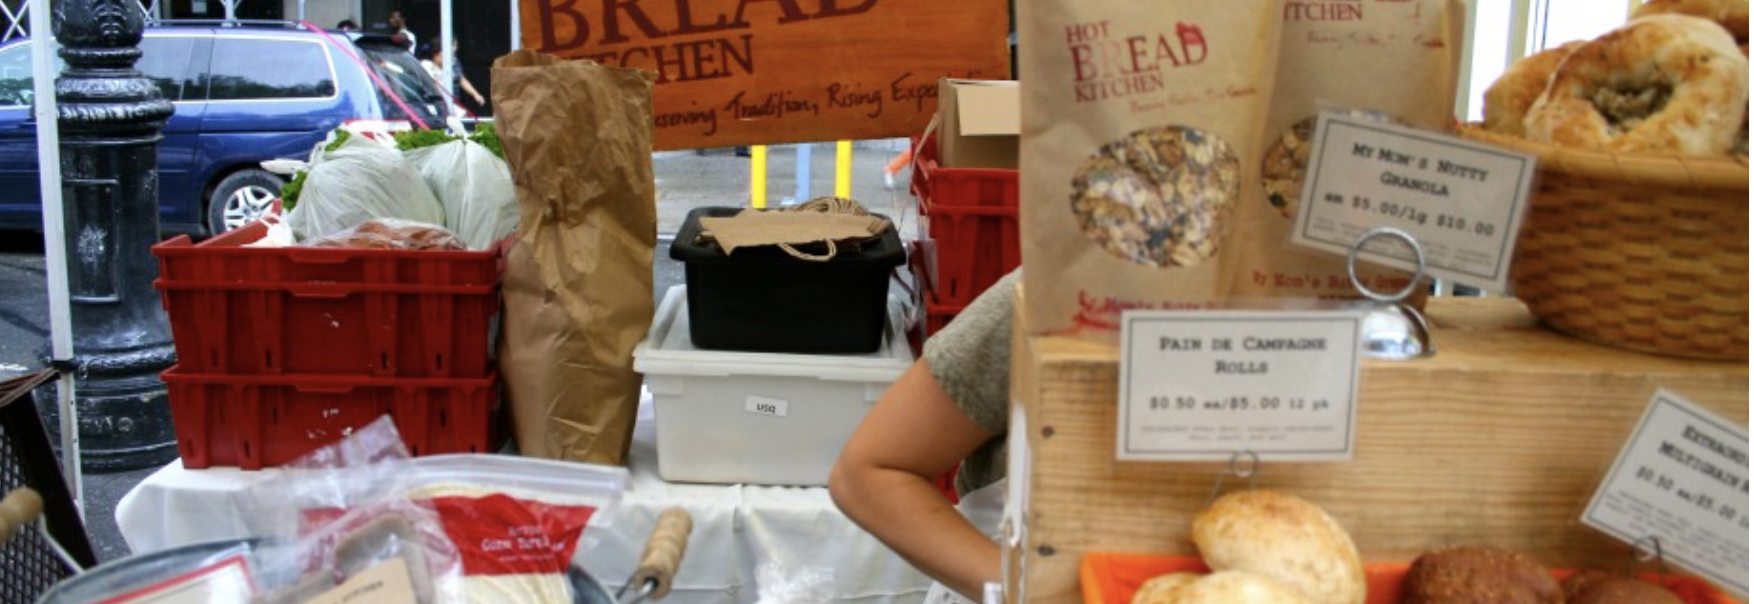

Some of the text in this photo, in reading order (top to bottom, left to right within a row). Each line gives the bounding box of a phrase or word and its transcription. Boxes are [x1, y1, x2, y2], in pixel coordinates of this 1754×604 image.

[538, 0, 879, 50] BRE
[1065, 20, 1110, 43] HOT
[1069, 21, 1208, 82] BREAD
[724, 91, 819, 119] Tradition,
[827, 82, 882, 119] Rising
[1073, 74, 1164, 102] KITCHEN
[1437, 160, 1489, 182] NUTTY
[1380, 171, 1449, 198] GRANOLA
[1437, 213, 1494, 236] $10.00
[1159, 336, 1327, 351] PAIN DE CAMPAGNE
[1215, 360, 1268, 374] ROLLS
